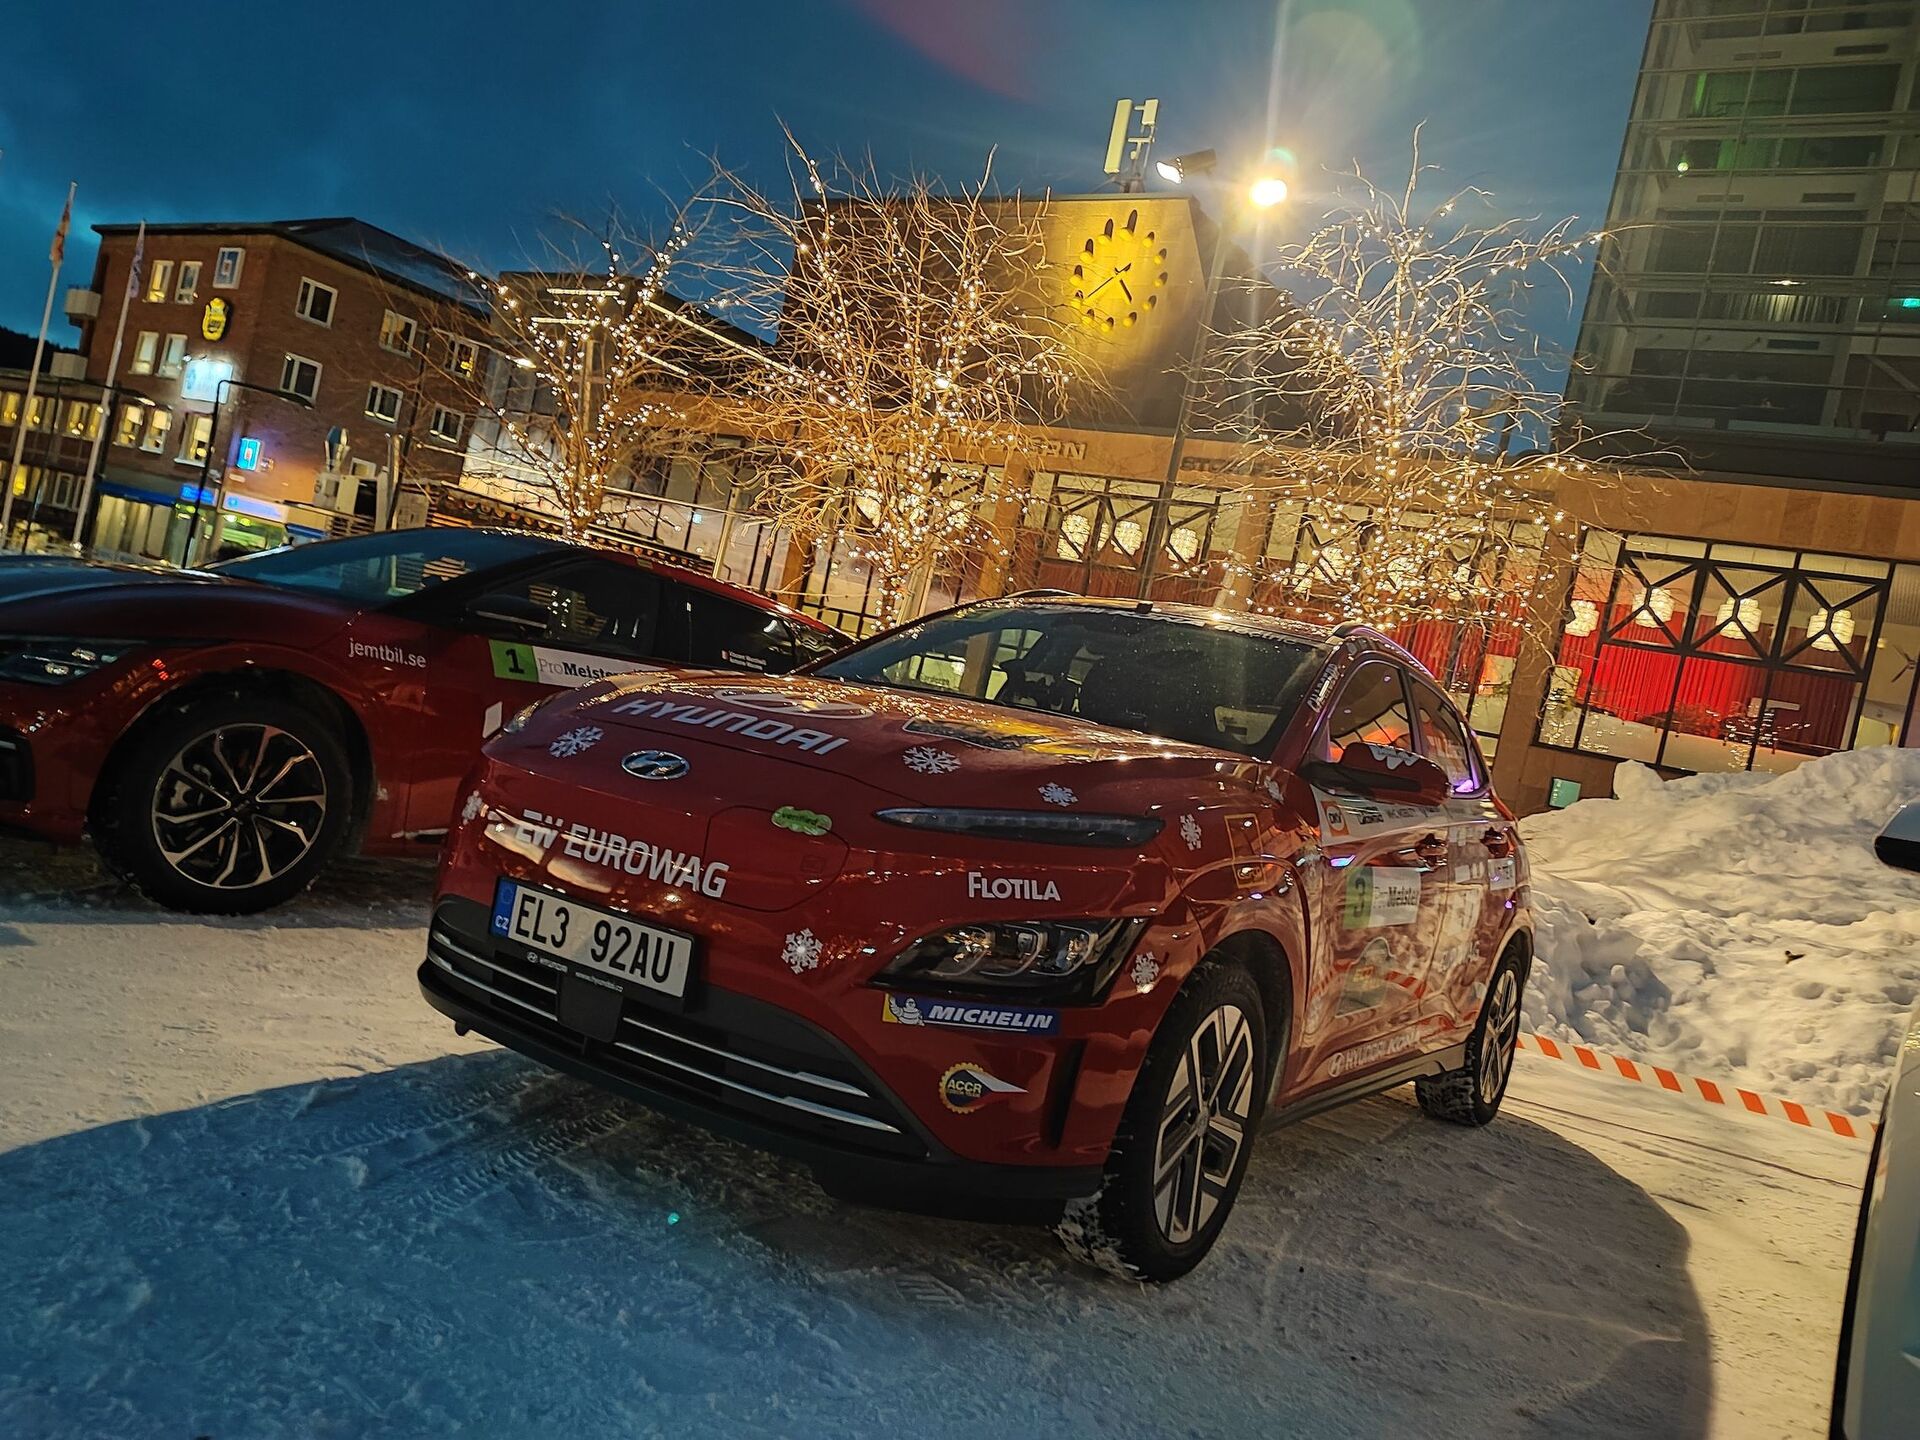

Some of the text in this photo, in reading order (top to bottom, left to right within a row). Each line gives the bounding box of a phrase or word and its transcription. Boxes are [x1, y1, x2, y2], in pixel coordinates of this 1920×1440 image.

[348, 637, 427, 668] jemtbil.se
[505, 648, 524, 674] 1
[611, 698, 850, 755] HYUNDAI
[563, 823, 729, 898] EUROWAG
[494, 914, 510, 930] CZ
[515, 893, 675, 983] EL3 92AU
[928, 1004, 1053, 1030] MICHELIN
